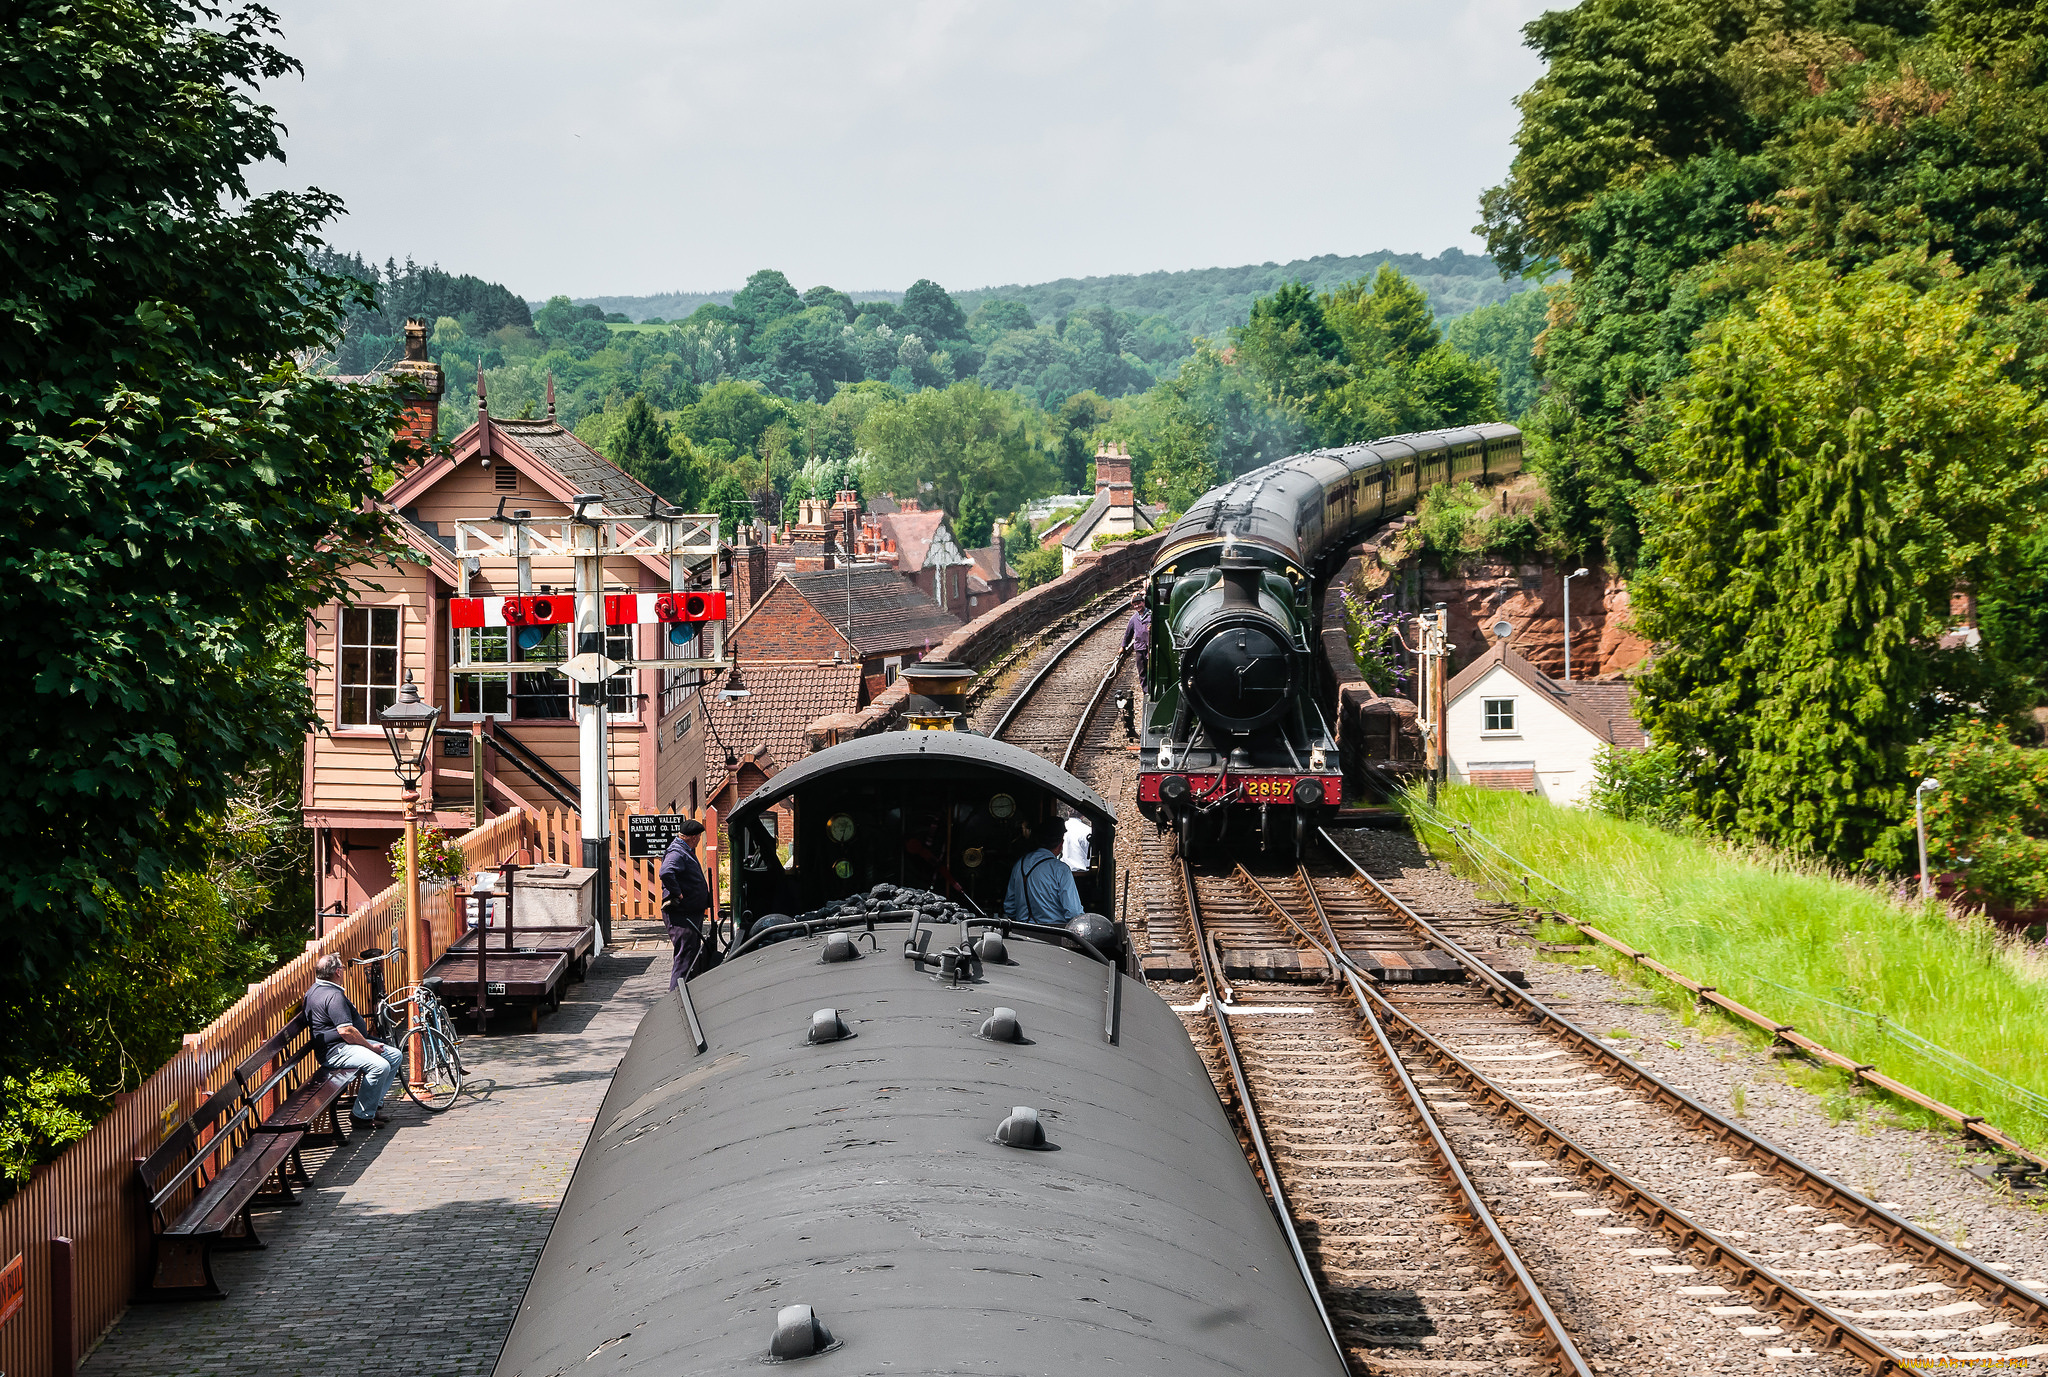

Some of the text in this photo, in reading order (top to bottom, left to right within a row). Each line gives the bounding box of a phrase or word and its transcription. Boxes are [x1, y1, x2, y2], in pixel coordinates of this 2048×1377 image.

[1248, 782, 1292, 796] 2857
[659, 816, 682, 824] VALLEY
[630, 824, 657, 832] RAILWAY
